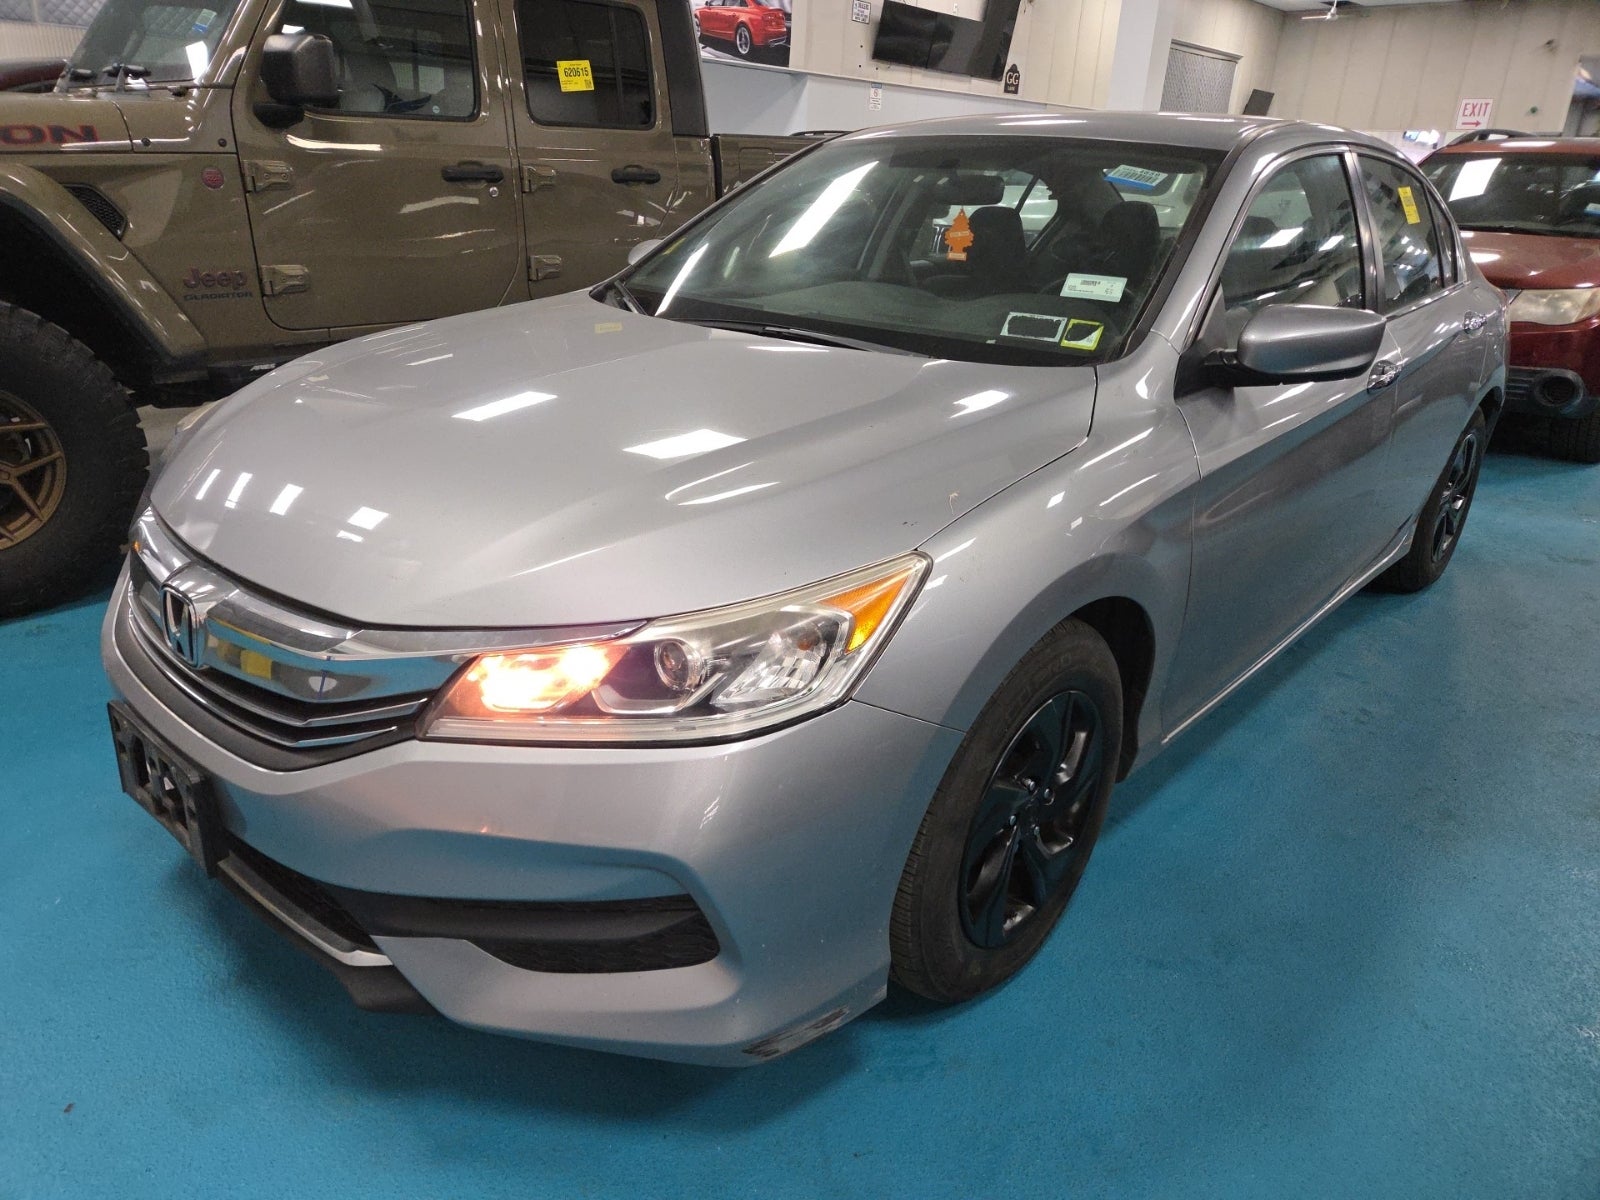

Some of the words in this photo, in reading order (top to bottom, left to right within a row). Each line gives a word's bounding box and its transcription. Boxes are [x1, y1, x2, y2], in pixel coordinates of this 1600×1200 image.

[564, 67, 589, 78] 620615
[1006, 72, 1019, 85] GG
[1462, 102, 1490, 117] EXIT
[182, 265, 248, 291] Jeep
[183, 291, 253, 301] GLADIATOR
